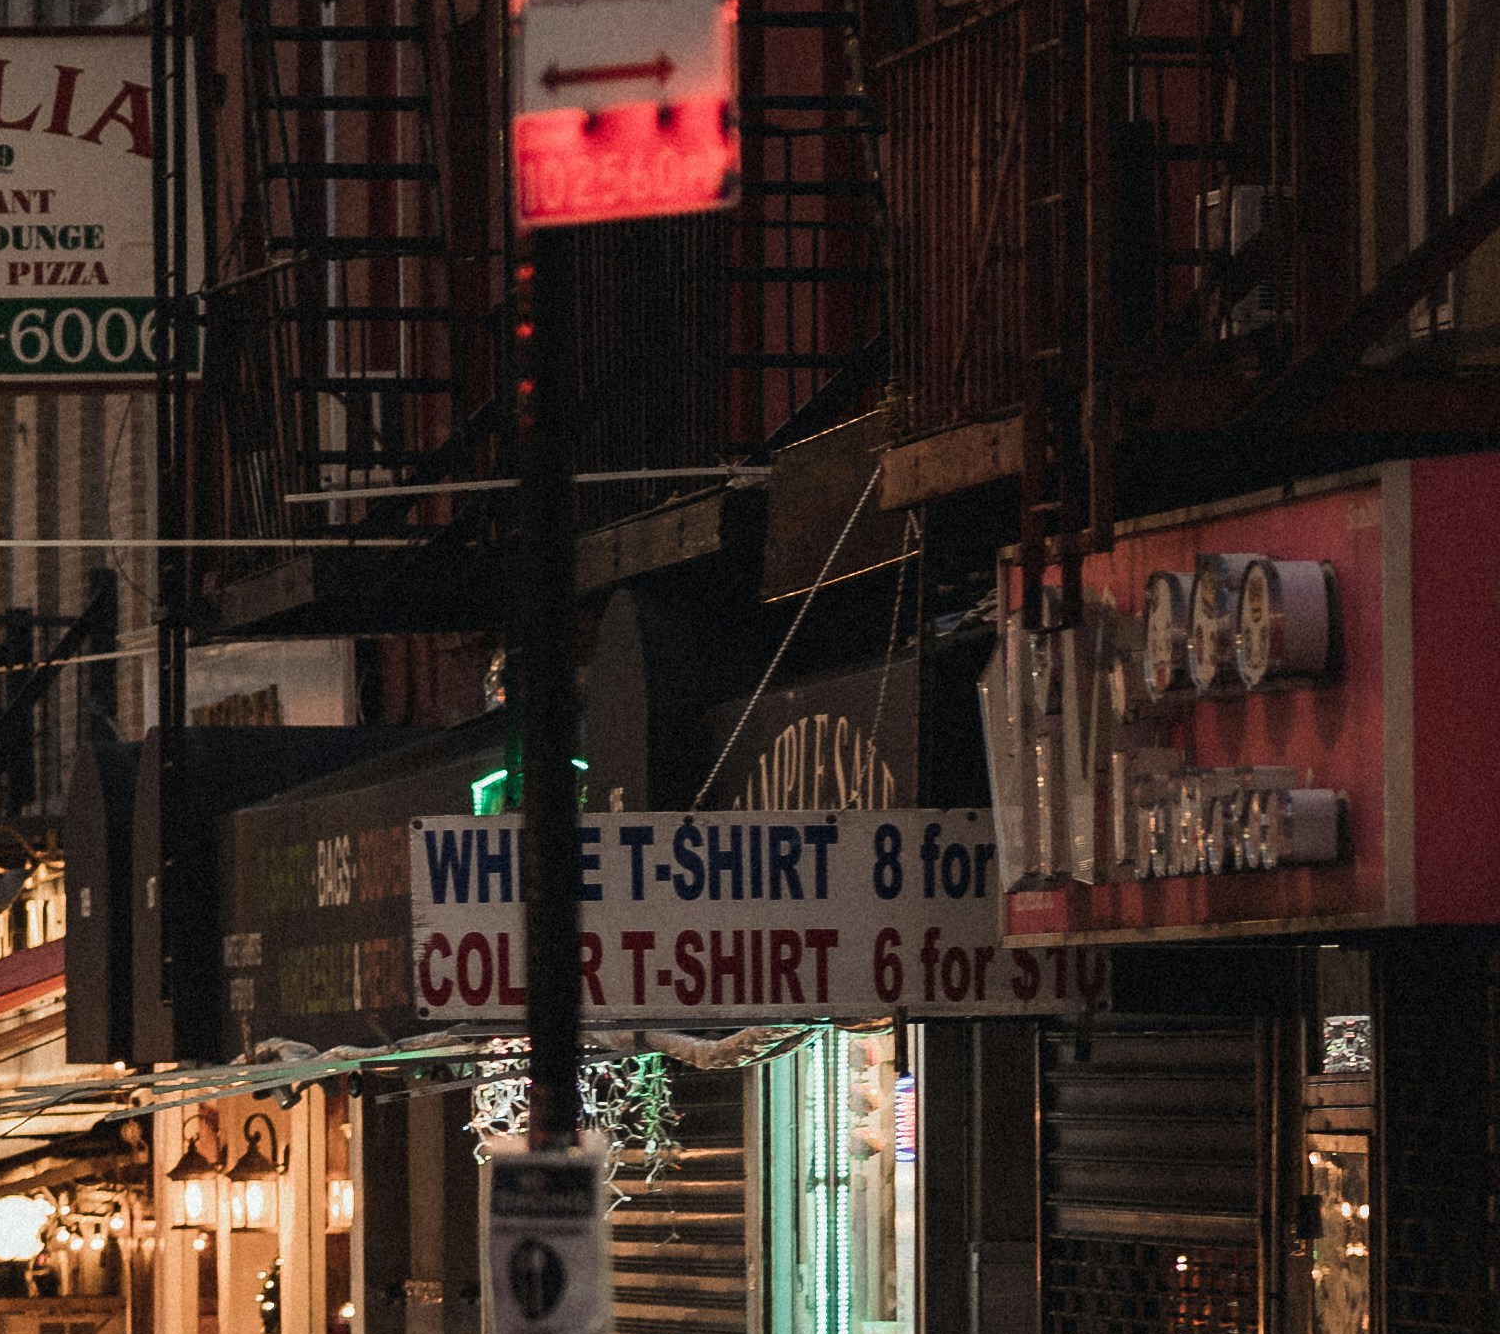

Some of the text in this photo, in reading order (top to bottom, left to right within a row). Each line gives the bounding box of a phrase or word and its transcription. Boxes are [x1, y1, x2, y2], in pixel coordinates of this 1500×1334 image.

[8, 261, 109, 285] PIZZA
[426, 828, 602, 903] WHIE
[621, 825, 837, 902] T-SHIRT
[874, 824, 901, 899] 8
[920, 825, 995, 898] for
[420, 933, 602, 1006] COLR
[623, 929, 838, 1006] T-SHIRT
[874, 929, 902, 1003] 6
[920, 928, 993, 1002] for
